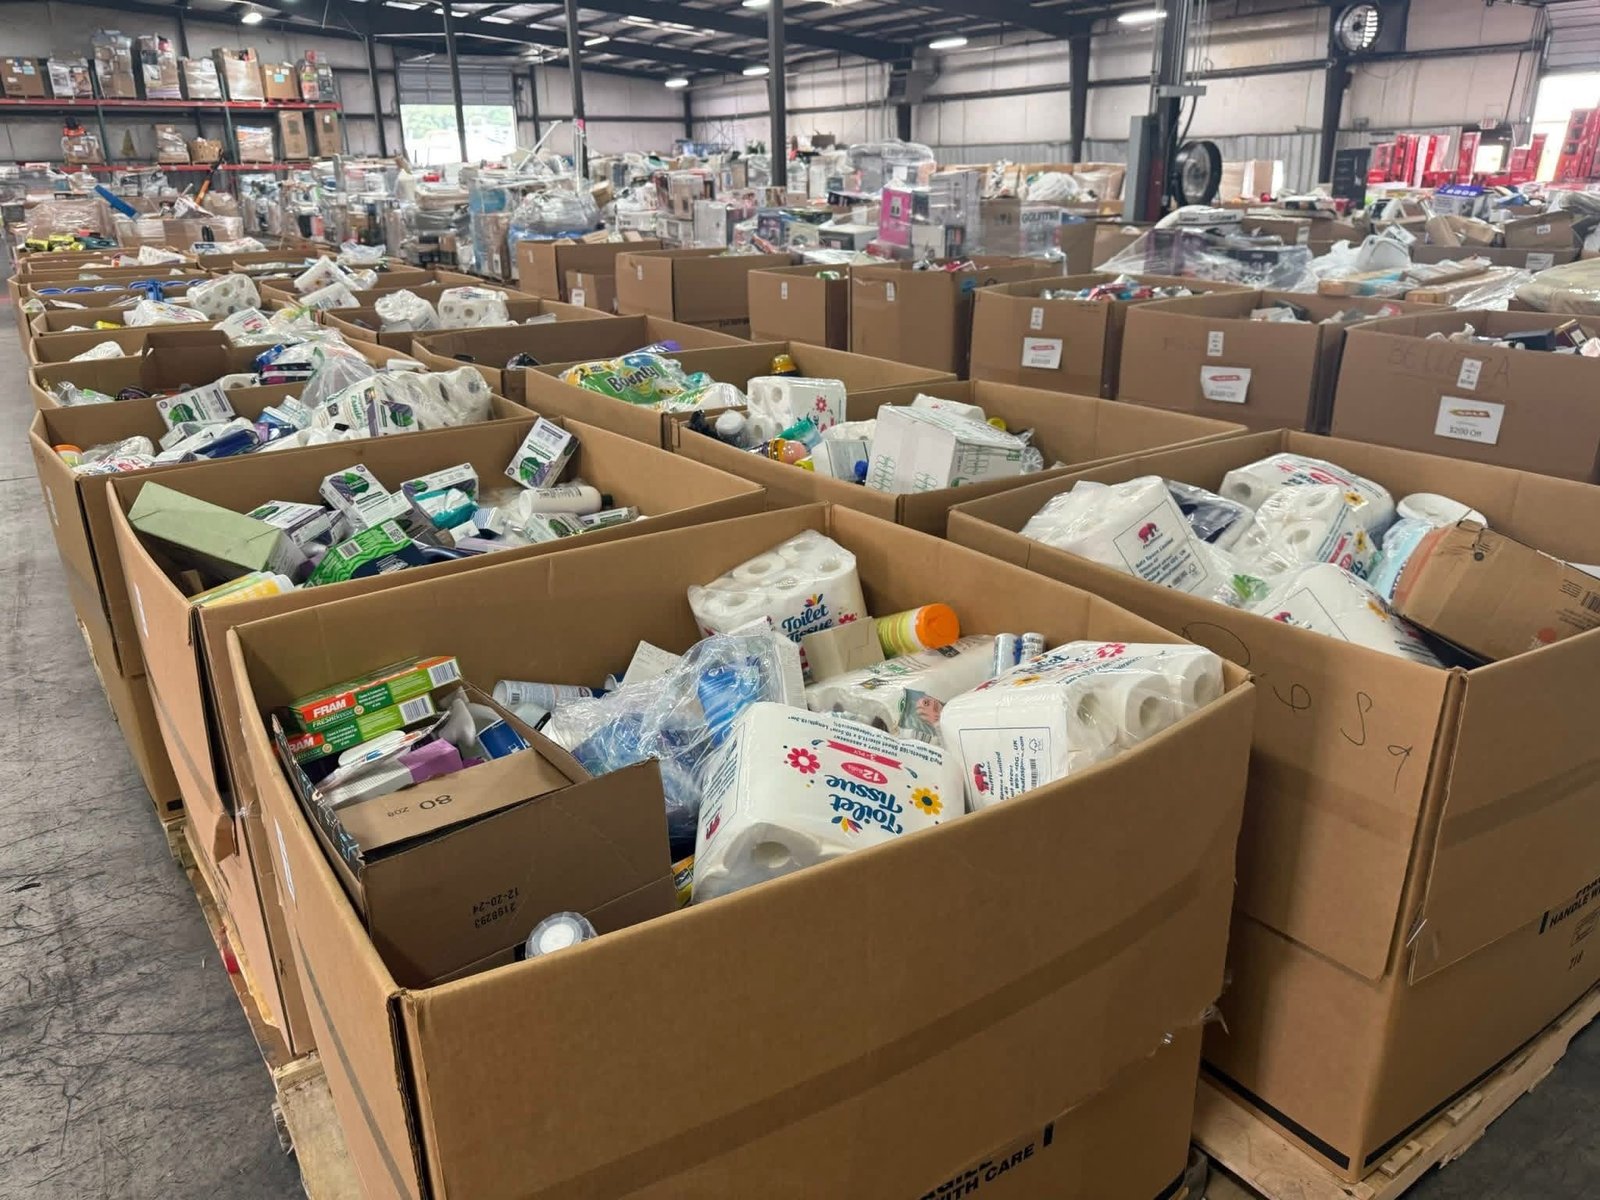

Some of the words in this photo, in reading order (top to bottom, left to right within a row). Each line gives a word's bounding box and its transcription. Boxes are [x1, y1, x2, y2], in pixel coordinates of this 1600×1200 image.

[607, 365, 660, 393] Bounty
[782, 604, 829, 633] Toilet
[313, 698, 347, 718] FRAM
[289, 736, 314, 753] RAM
[862, 768, 882, 783] 12
[420, 795, 453, 810] 80
[824, 774, 903, 814] Tissue
[829, 793, 903, 835] Toilet
[473, 888, 520, 914] 12-20-24
[984, 1143, 1035, 1183] CARE
